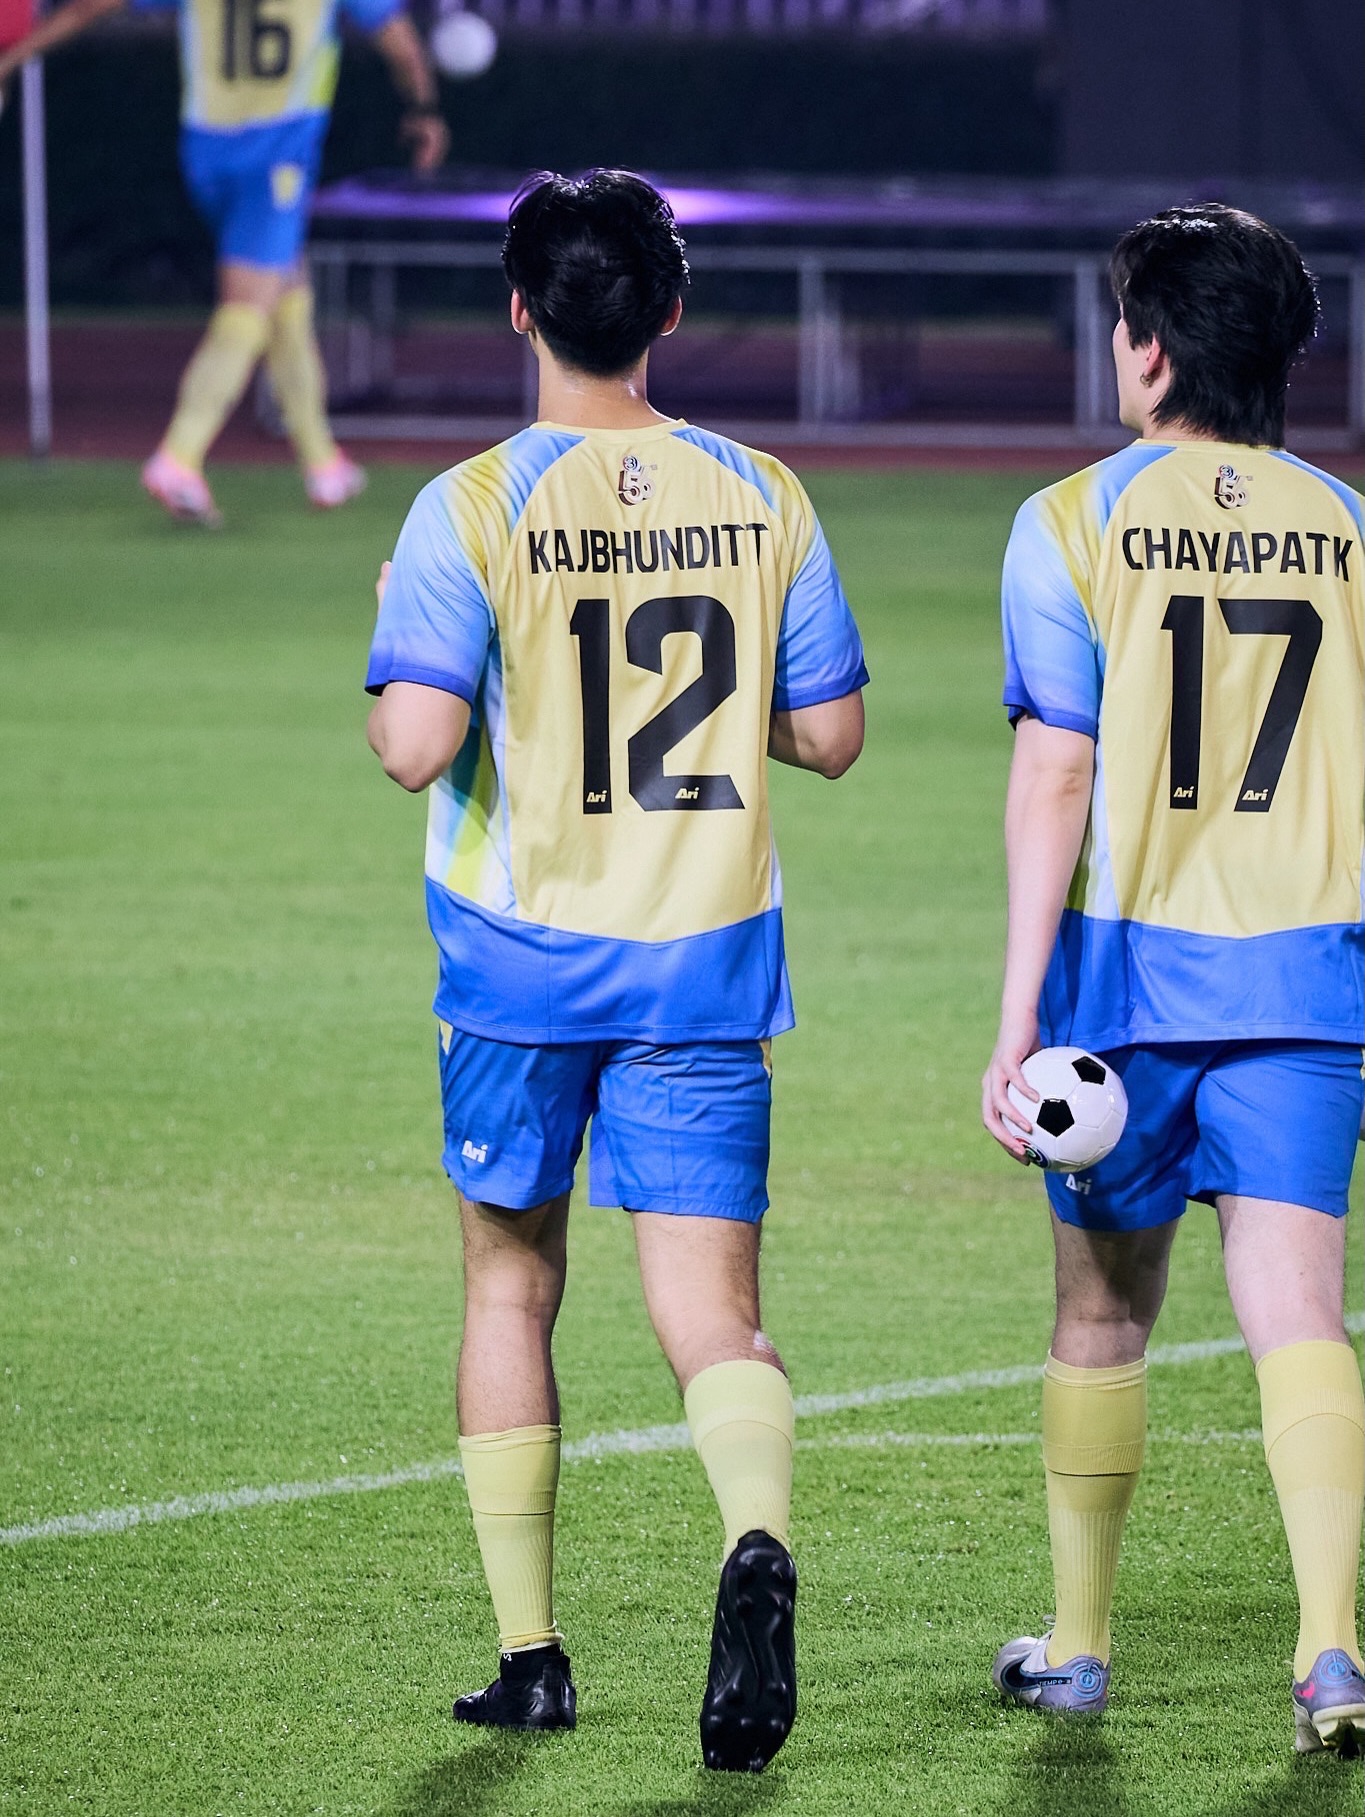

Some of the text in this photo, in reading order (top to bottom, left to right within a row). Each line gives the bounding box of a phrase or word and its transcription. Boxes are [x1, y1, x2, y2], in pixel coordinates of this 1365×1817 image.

[222, 0, 291, 80] 16
[528, 523, 768, 574] KAJBHUNDITT
[1122, 527, 1353, 582] CHAYAPATK
[570, 595, 745, 814] 12
[1160, 595, 1323, 812] 17
[586, 790, 607, 803] Ari
[675, 787, 699, 799] Ari
[1173, 786, 1194, 798] Ari
[1242, 789, 1269, 801] Ari
[461, 1140, 488, 1163] Ari
